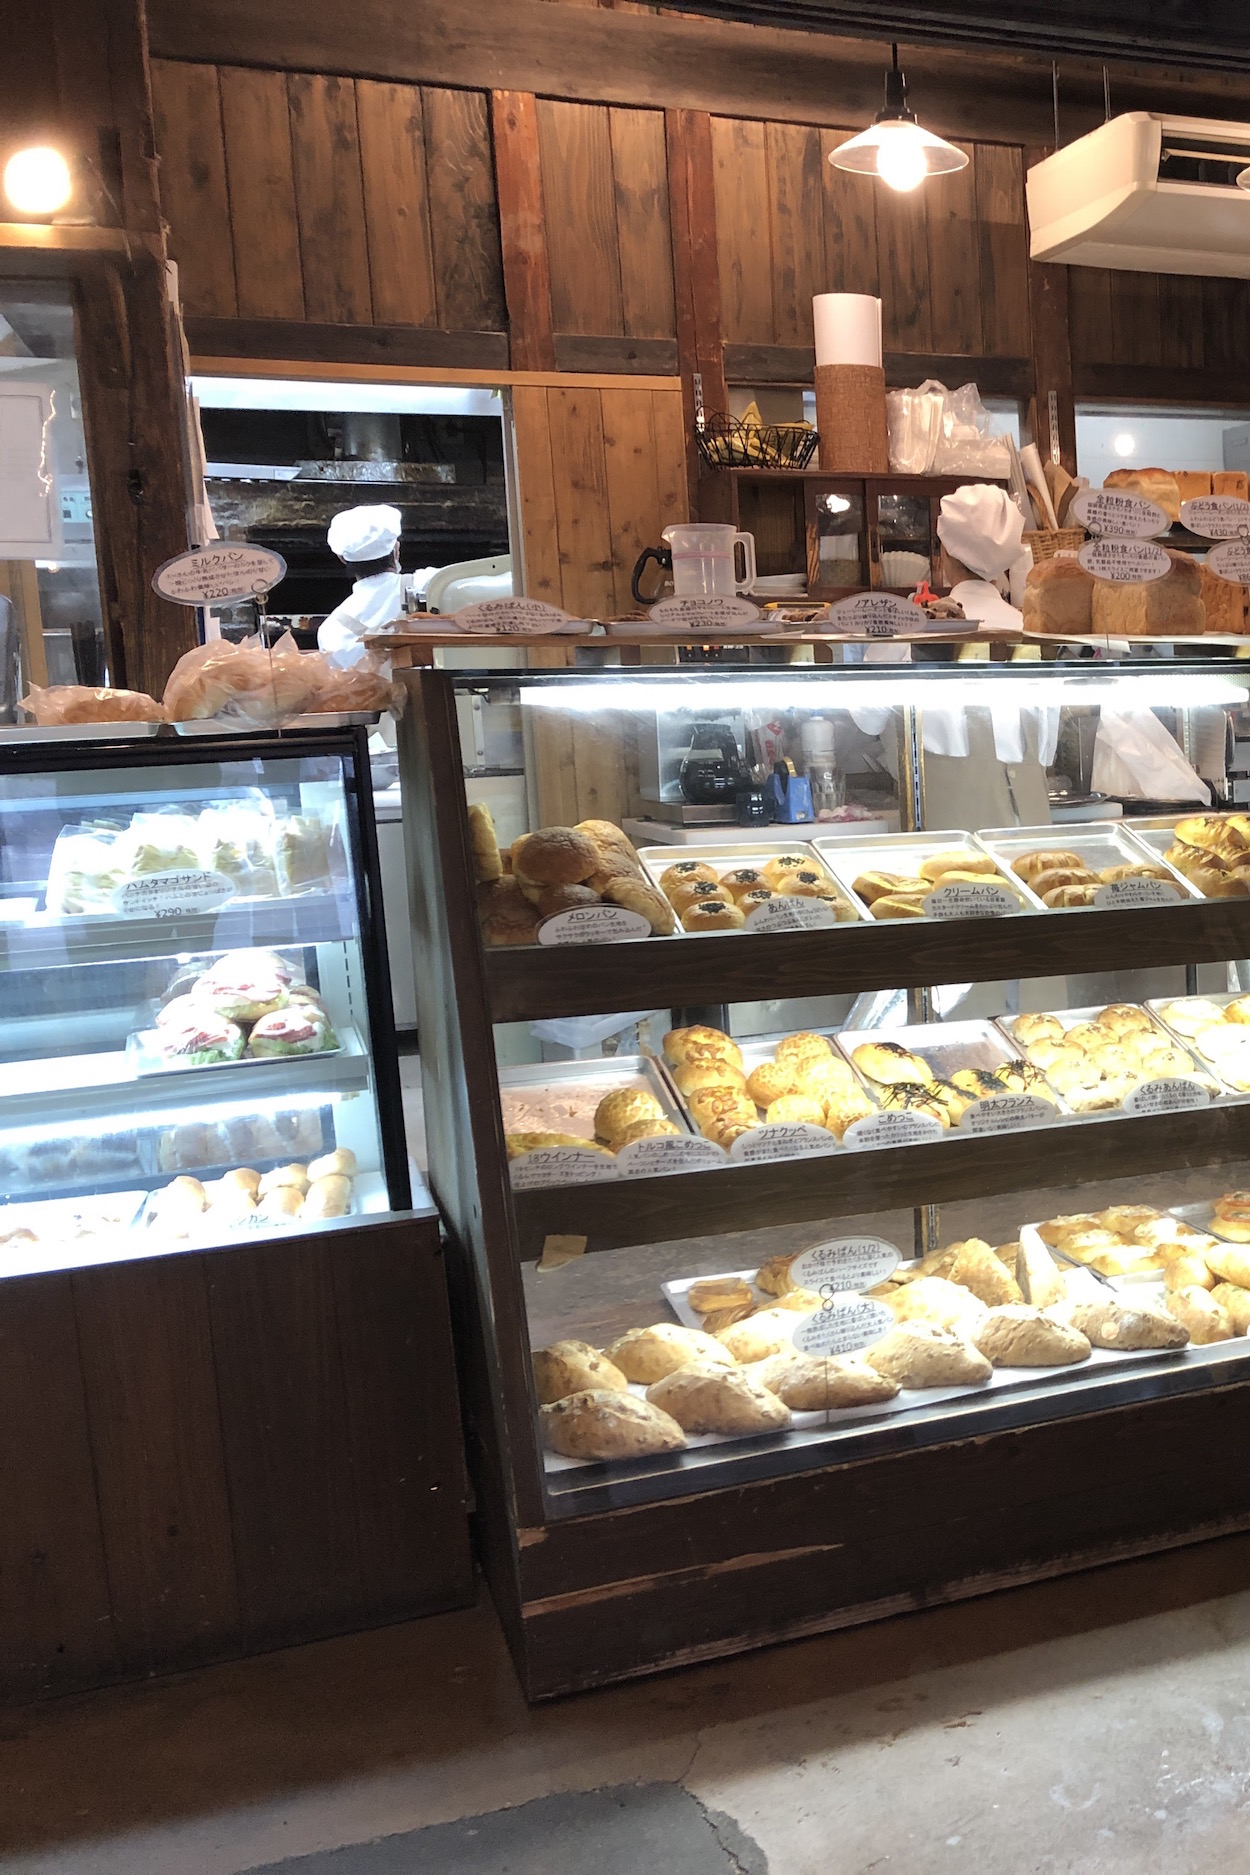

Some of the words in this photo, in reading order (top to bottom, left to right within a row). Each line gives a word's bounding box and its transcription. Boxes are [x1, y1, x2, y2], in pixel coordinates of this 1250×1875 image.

[1096, 494, 1151, 509] 全粒粉食パン
[1104, 524, 1124, 535] ¥390
[191, 552, 243, 567] ミルクパン
[1110, 572, 1130, 580] ¥200
[202, 588, 229, 599] ¥220
[680, 599, 723, 607] チョコノワ
[855, 599, 896, 608] ノアレザン
[127, 872, 211, 889] ハムタマゴサンド
[1111, 881, 1161, 892] 苺ジャムパン
[944, 886, 999, 897] クリームパン
[154, 907, 182, 918] ¥290
[568, 909, 617, 921] メロンパン
[1140, 1081, 1195, 1095] くるみあんぱん
[980, 1096, 1034, 1111] 明太フランス
[878, 1112, 914, 1124] こめっこ
[759, 1125, 807, 1139] ツナクッペ
[638, 1140, 711, 1151] トルコ風こめっこ
[528, 1151, 595, 1163] 18ウインナー
[812, 1243, 880, 1260] くるみぱん(1/2)
[812, 1301, 875, 1324] くるみぱん(大)
[830, 1343, 853, 1355] ¥410
